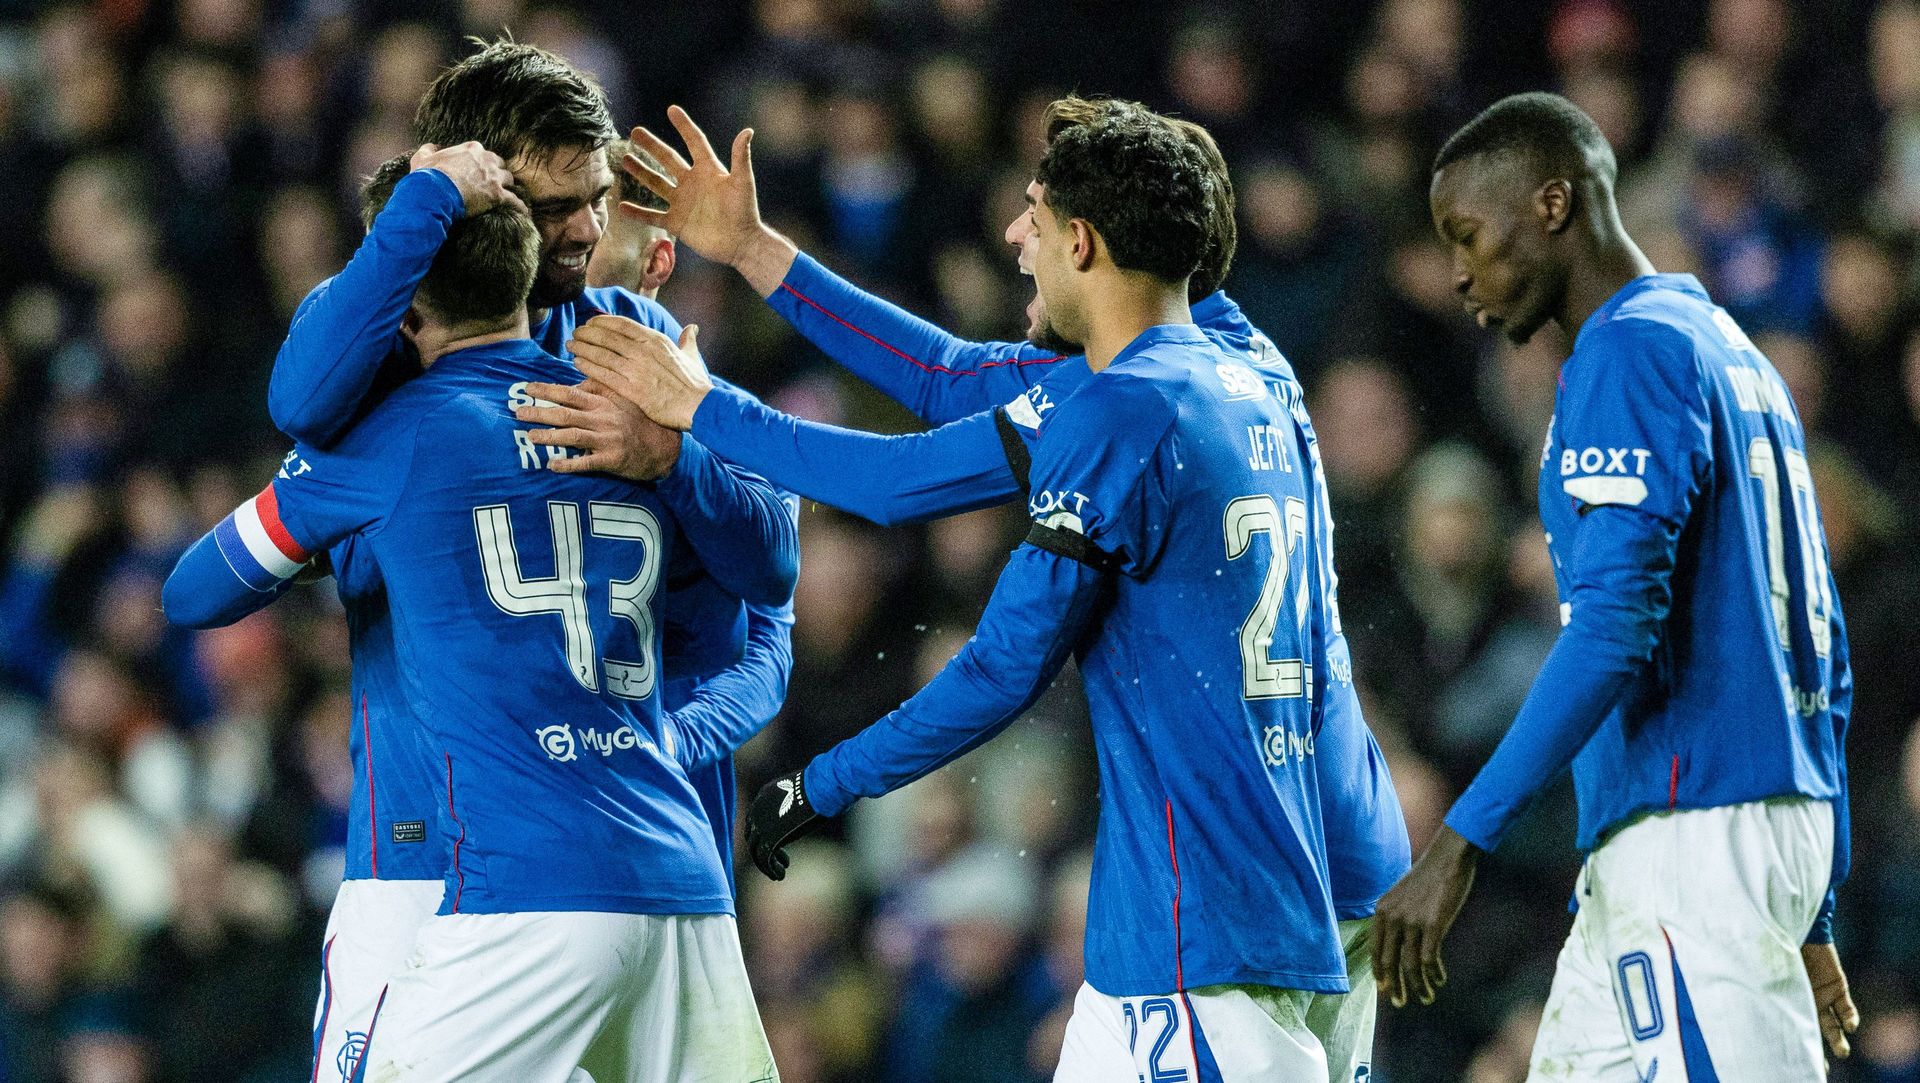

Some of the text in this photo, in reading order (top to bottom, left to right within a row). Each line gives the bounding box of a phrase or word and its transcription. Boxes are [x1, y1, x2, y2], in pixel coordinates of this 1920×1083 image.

[1560, 447, 1651, 476] BOXT
[1749, 436, 1832, 659] 10
[472, 500, 662, 700] 43
